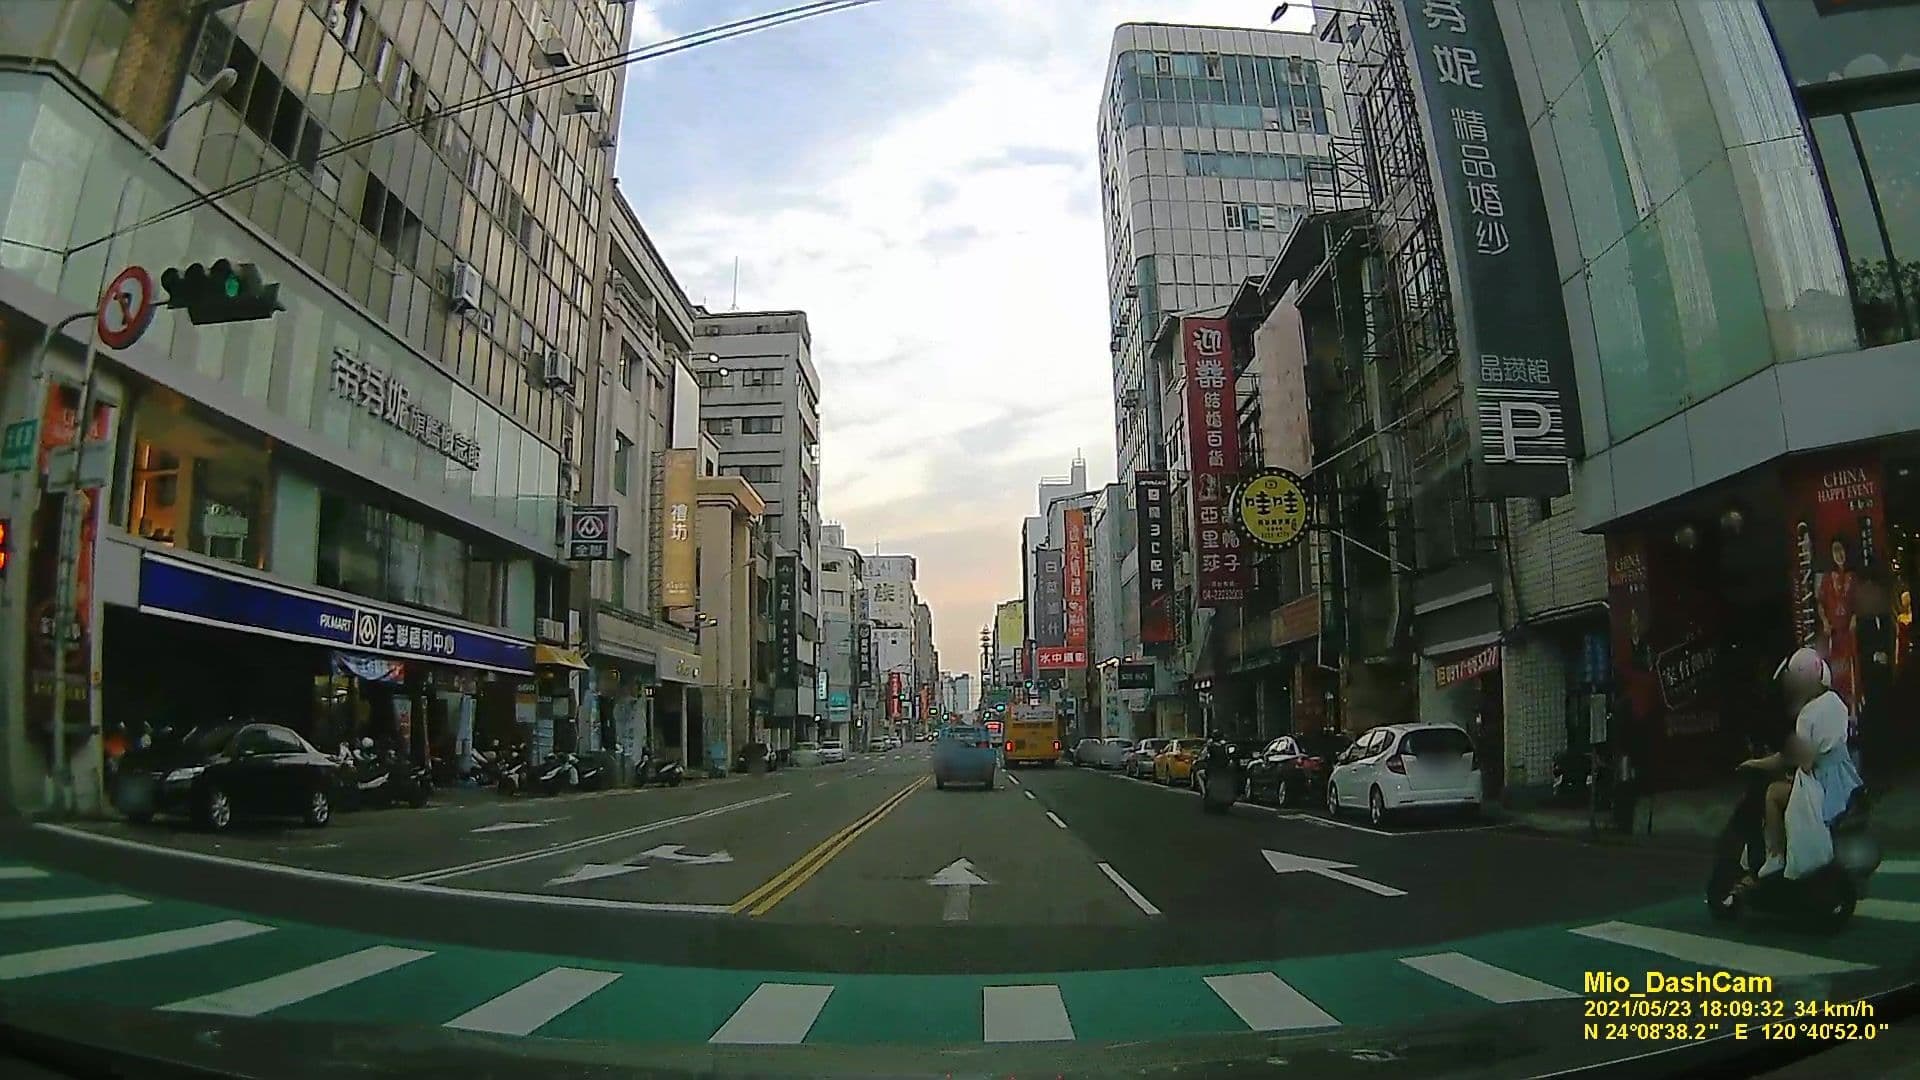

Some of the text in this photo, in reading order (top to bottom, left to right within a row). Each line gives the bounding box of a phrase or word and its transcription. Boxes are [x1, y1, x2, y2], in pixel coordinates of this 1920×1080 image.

[1451, 107, 1509, 255] 精品婚紗
[1499, 401, 1552, 460] P
[1823, 468, 1867, 488] CHINA
[1245, 489, 1298, 515] 哇哇
